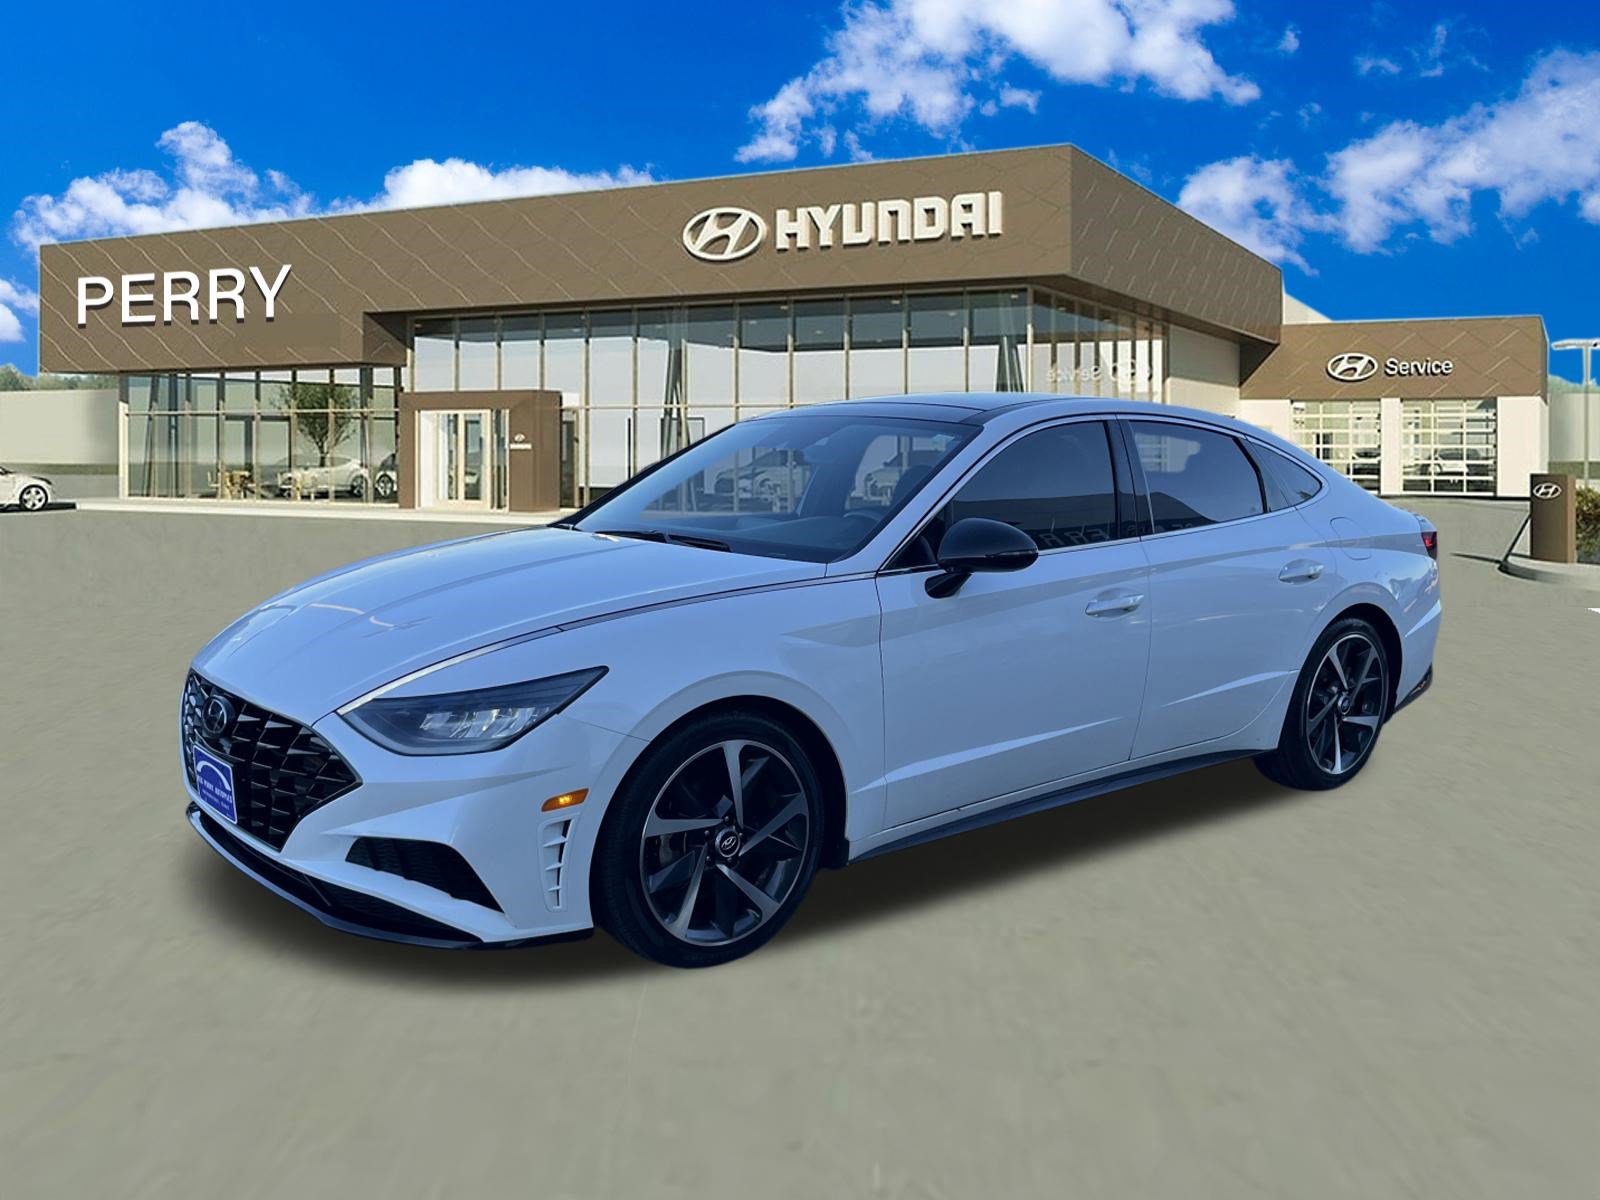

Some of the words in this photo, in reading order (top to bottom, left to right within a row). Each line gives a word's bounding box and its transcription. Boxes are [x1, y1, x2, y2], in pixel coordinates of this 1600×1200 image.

[776, 191, 1002, 250] HYUNDAI
[77, 264, 292, 327] PERRY
[1385, 357, 1453, 375] Service
